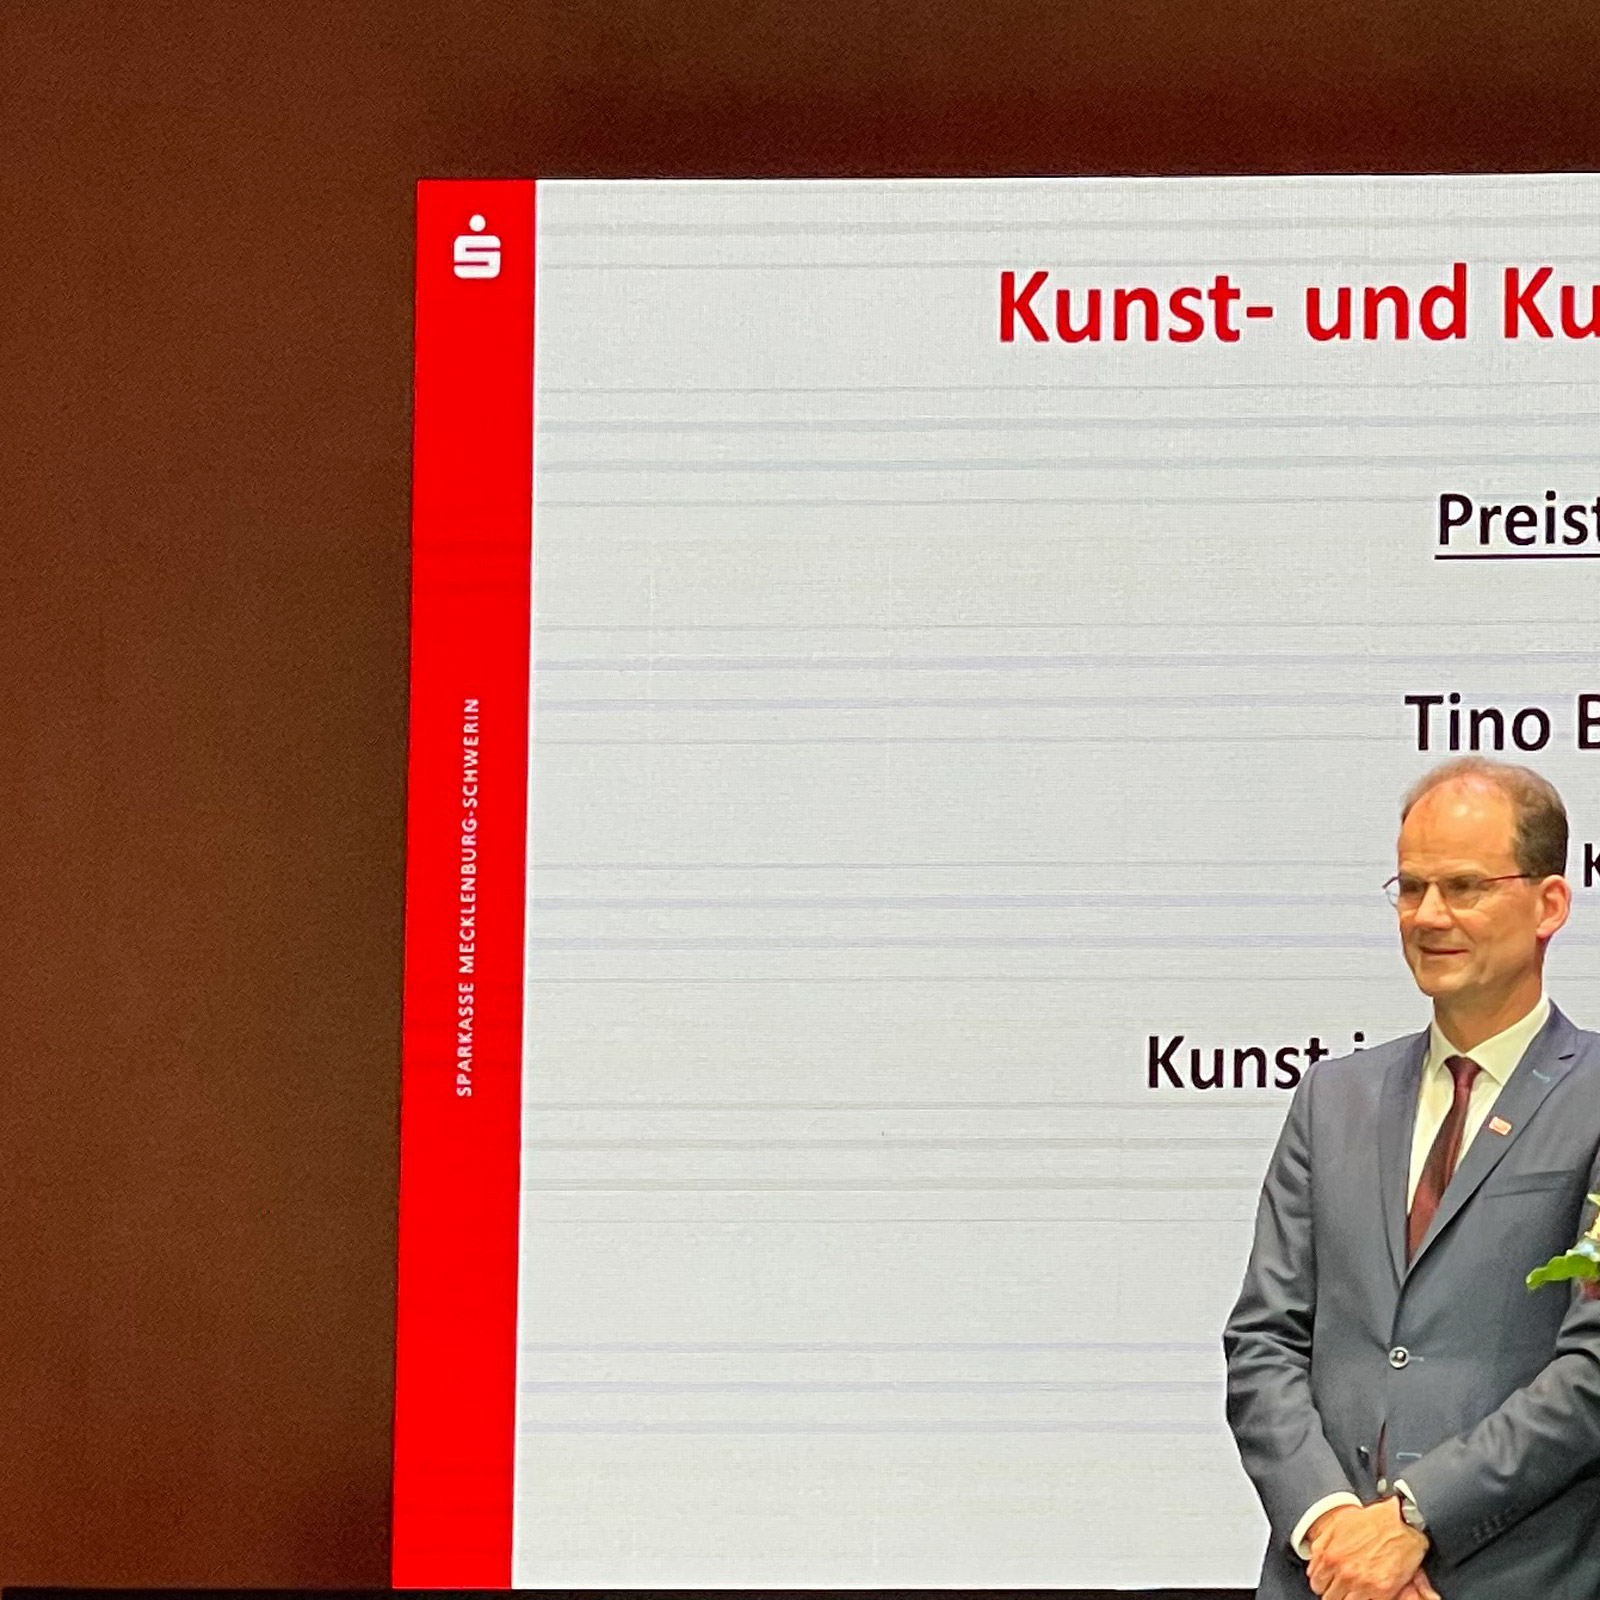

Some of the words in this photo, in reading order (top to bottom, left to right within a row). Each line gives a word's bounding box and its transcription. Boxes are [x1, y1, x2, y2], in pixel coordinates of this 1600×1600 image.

[999, 271, 1274, 344] Kunst-
[1306, 262, 1467, 342] und
[1404, 692, 1550, 752] Tino
[458, 699, 480, 974] MECKLENBURG-SCHWERIN
[456, 983, 476, 1097] SPARKASSE
[1148, 1035, 1329, 1089] Kunst
